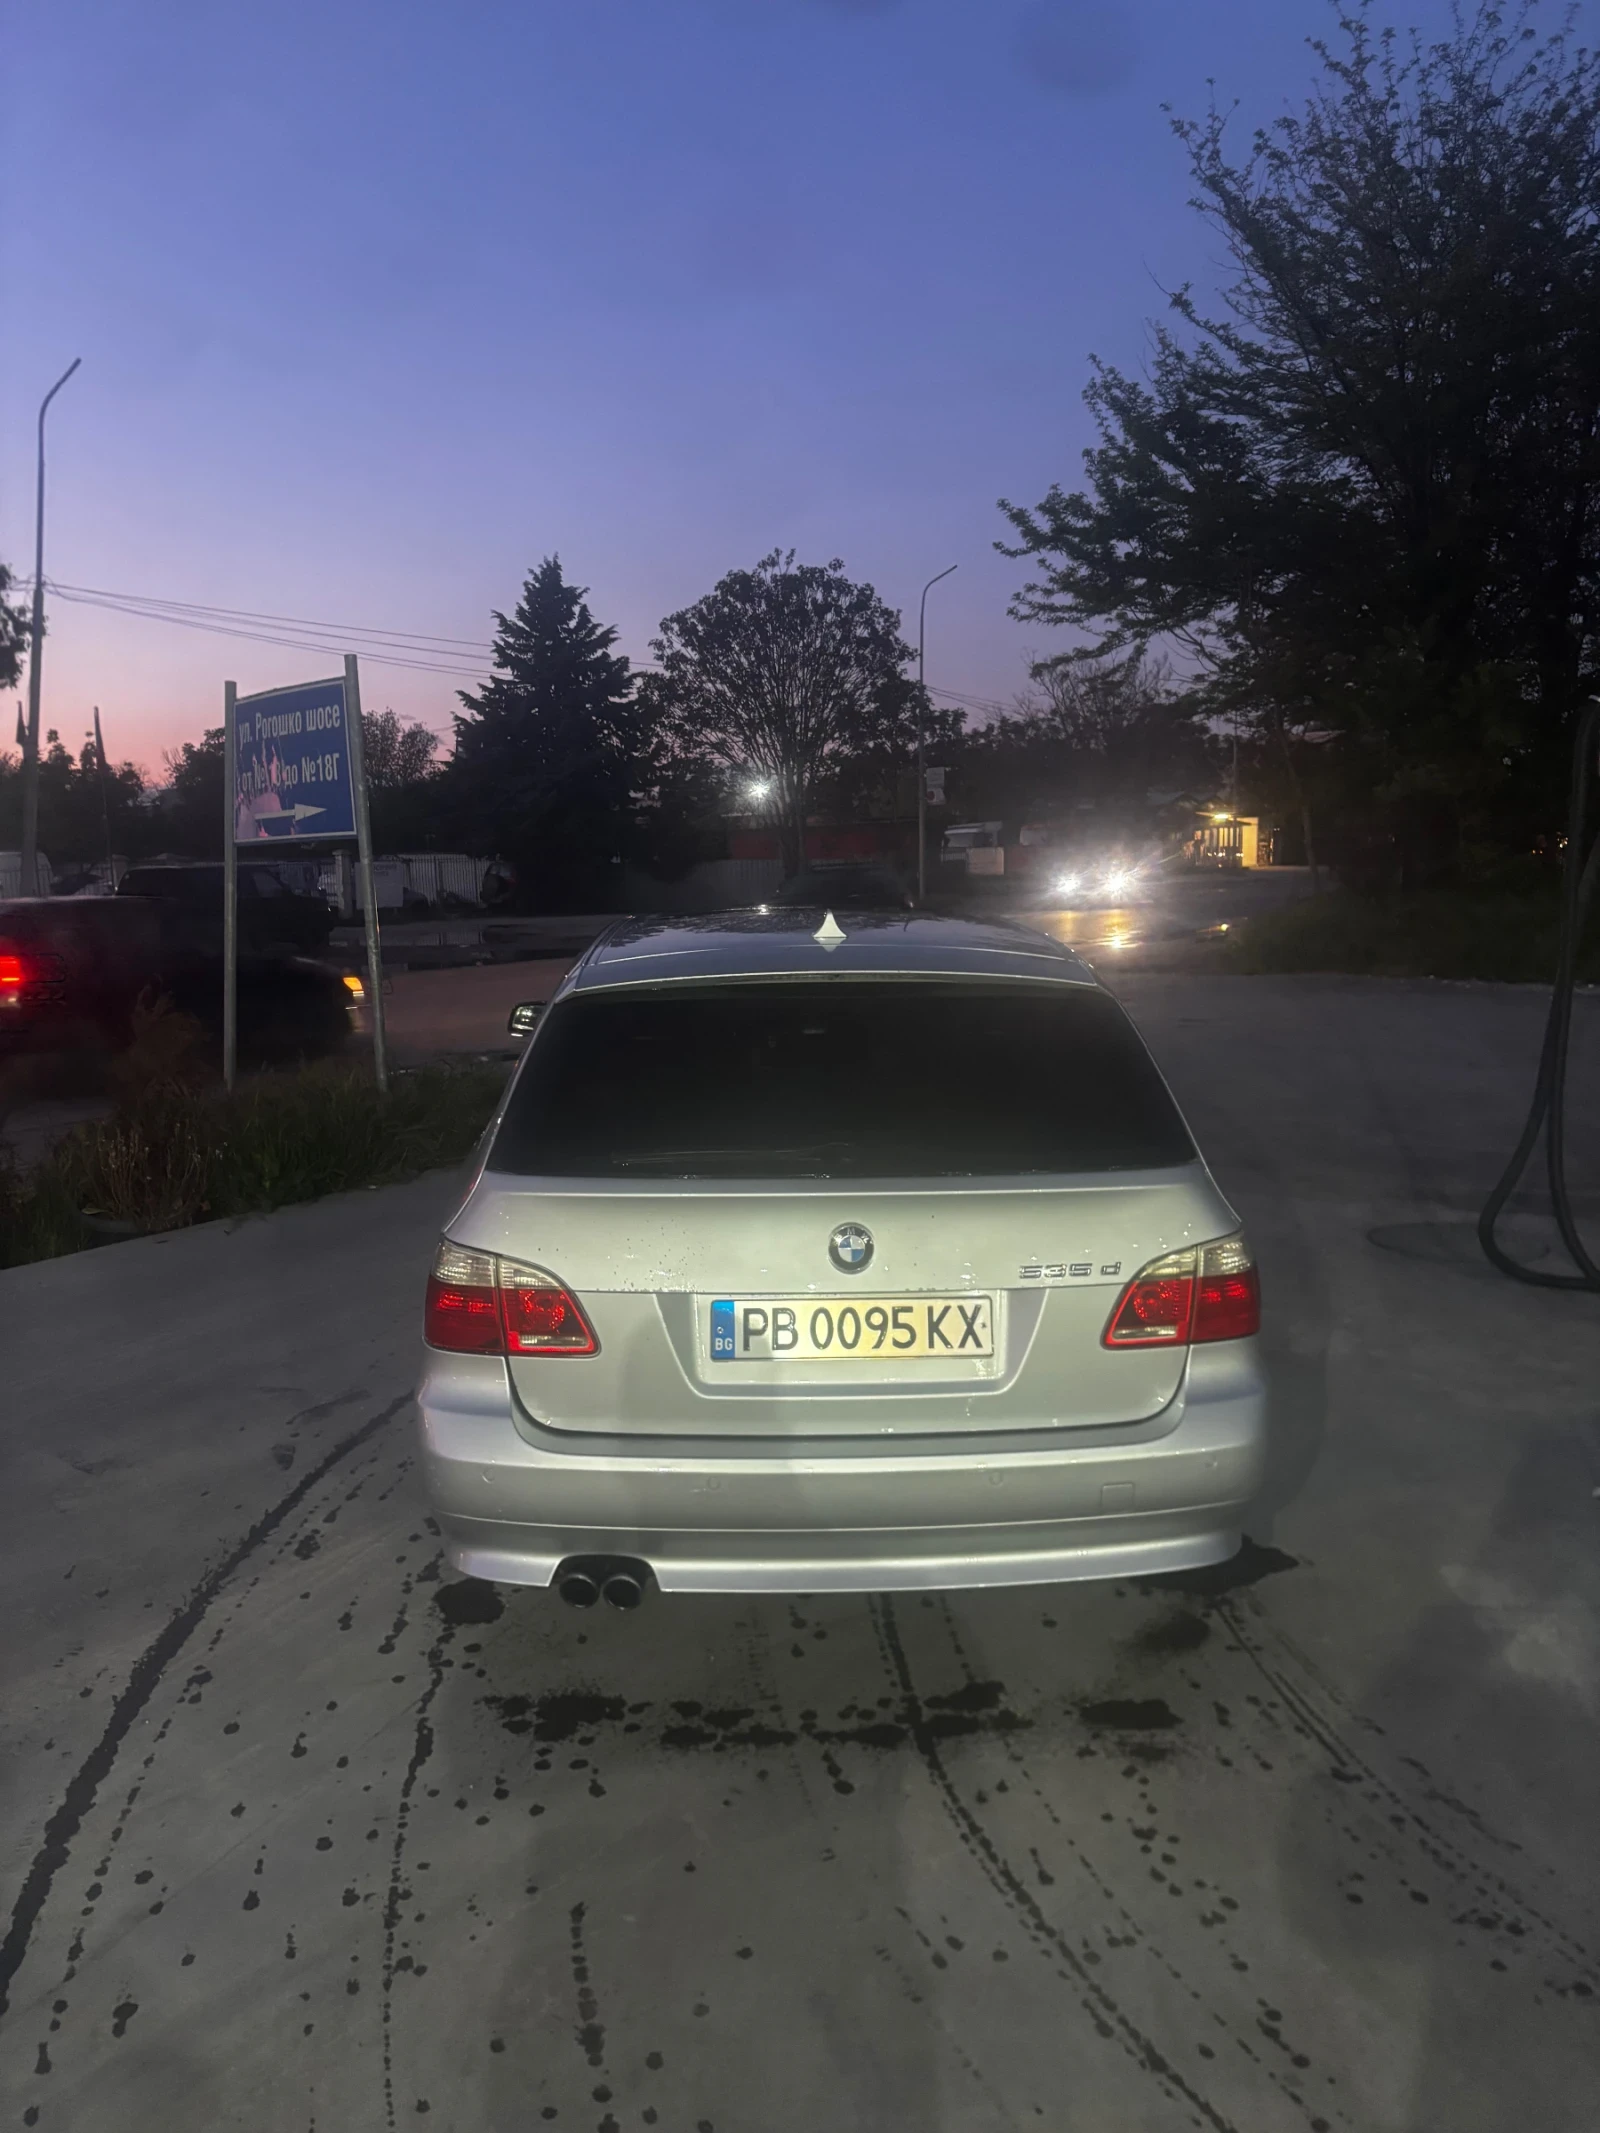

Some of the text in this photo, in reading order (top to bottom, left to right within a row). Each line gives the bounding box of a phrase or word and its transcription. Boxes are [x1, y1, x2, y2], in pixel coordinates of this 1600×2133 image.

[239, 704, 341, 751] ул. Рогошко шосе
[284, 764, 298, 789] до
[301, 752, 340, 783] №18Г
[1019, 1261, 1122, 1279] 535 d
[714, 1304, 983, 1352] BG PB 0095 KX
